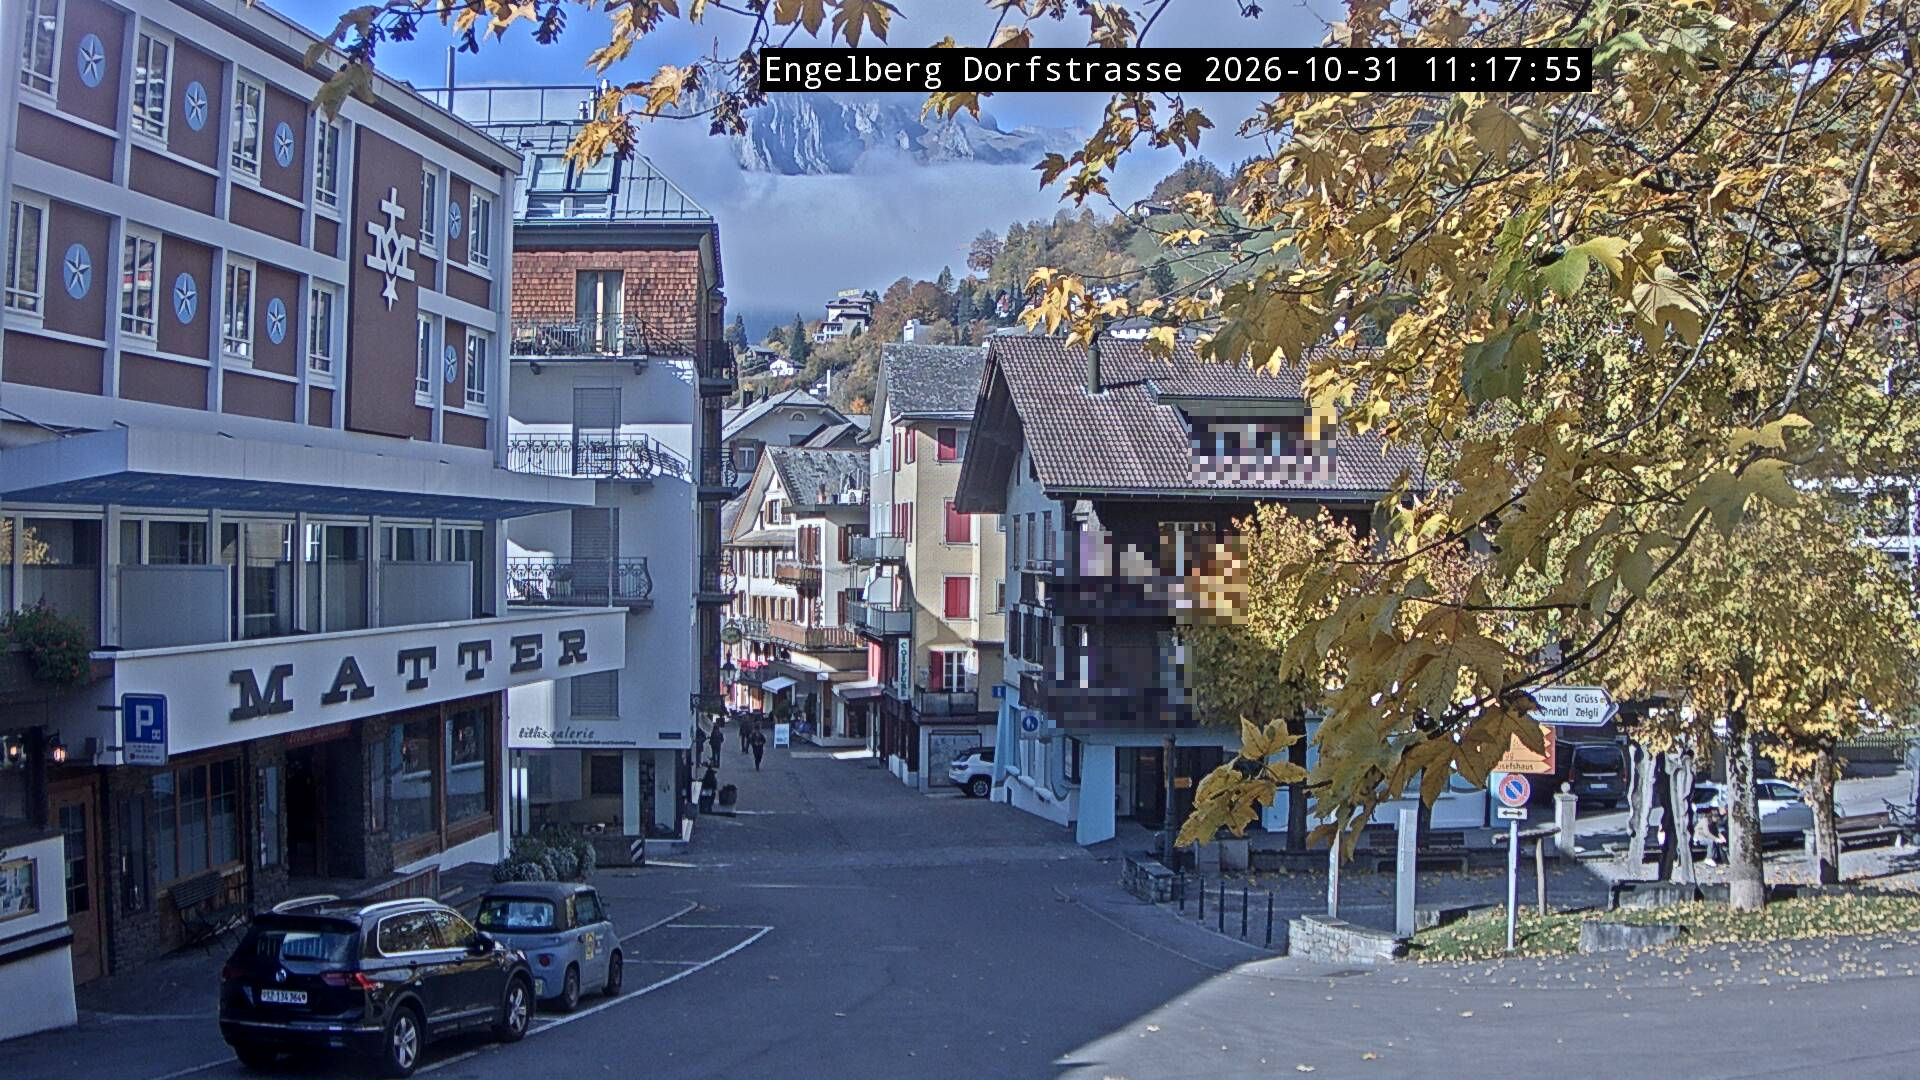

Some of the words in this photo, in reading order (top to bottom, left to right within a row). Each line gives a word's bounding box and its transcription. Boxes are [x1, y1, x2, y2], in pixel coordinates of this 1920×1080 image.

[229, 629, 588, 721] MATTER
[1538, 692, 1568, 703] hwand
[135, 704, 154, 738] P
